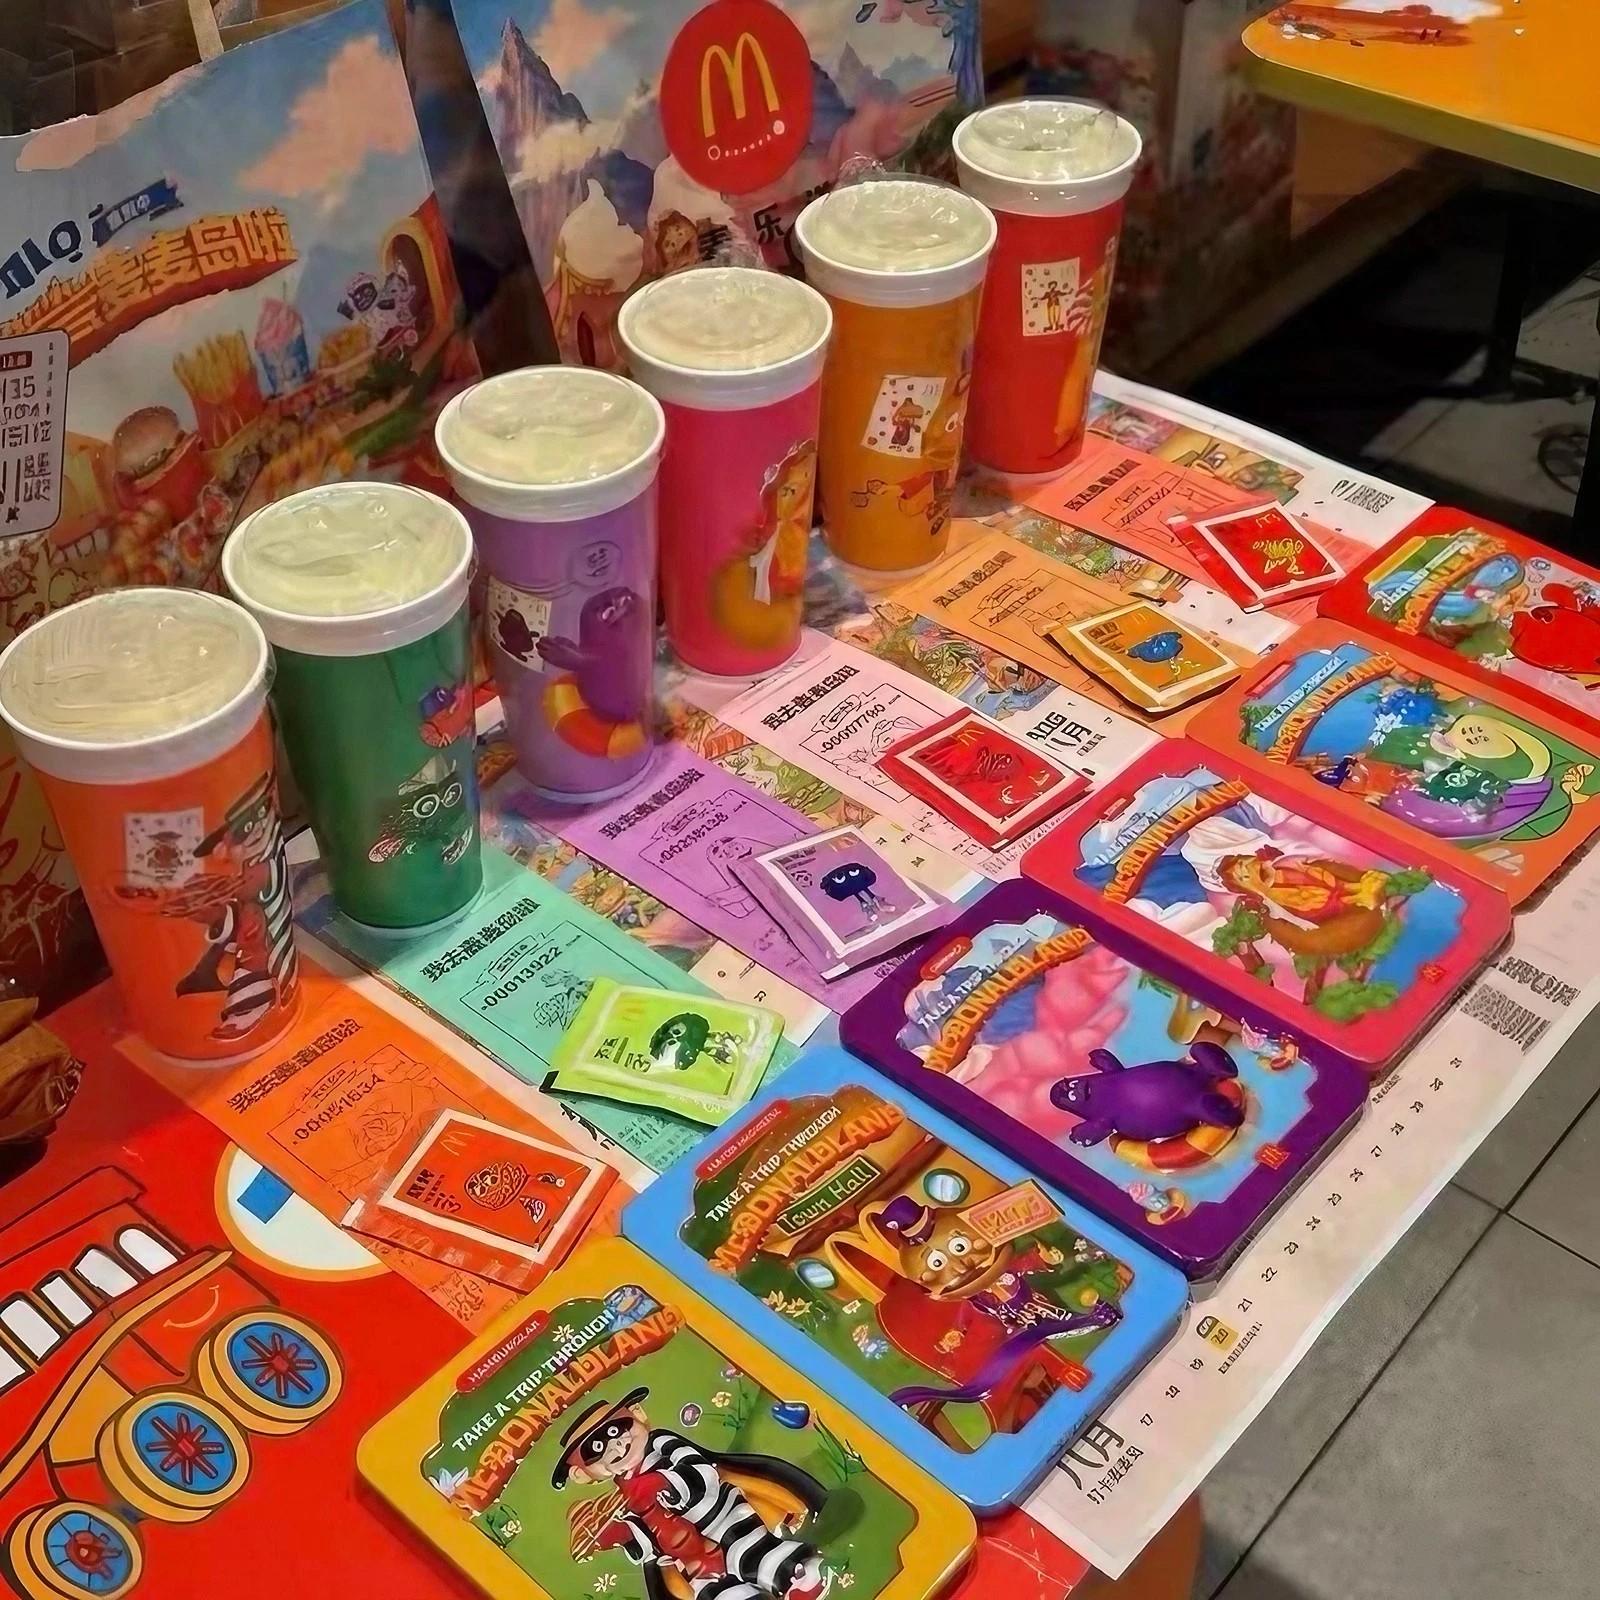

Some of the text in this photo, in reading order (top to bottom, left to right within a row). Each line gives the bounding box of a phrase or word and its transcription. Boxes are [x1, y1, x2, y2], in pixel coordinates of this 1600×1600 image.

[777, 1165, 873, 1230] Town Hall
[452, 1412, 497, 1452] TAKE
[495, 1400, 512, 1418] A
[505, 1369, 543, 1404] TRIP
[1055, 1418, 1125, 1491] 八月
